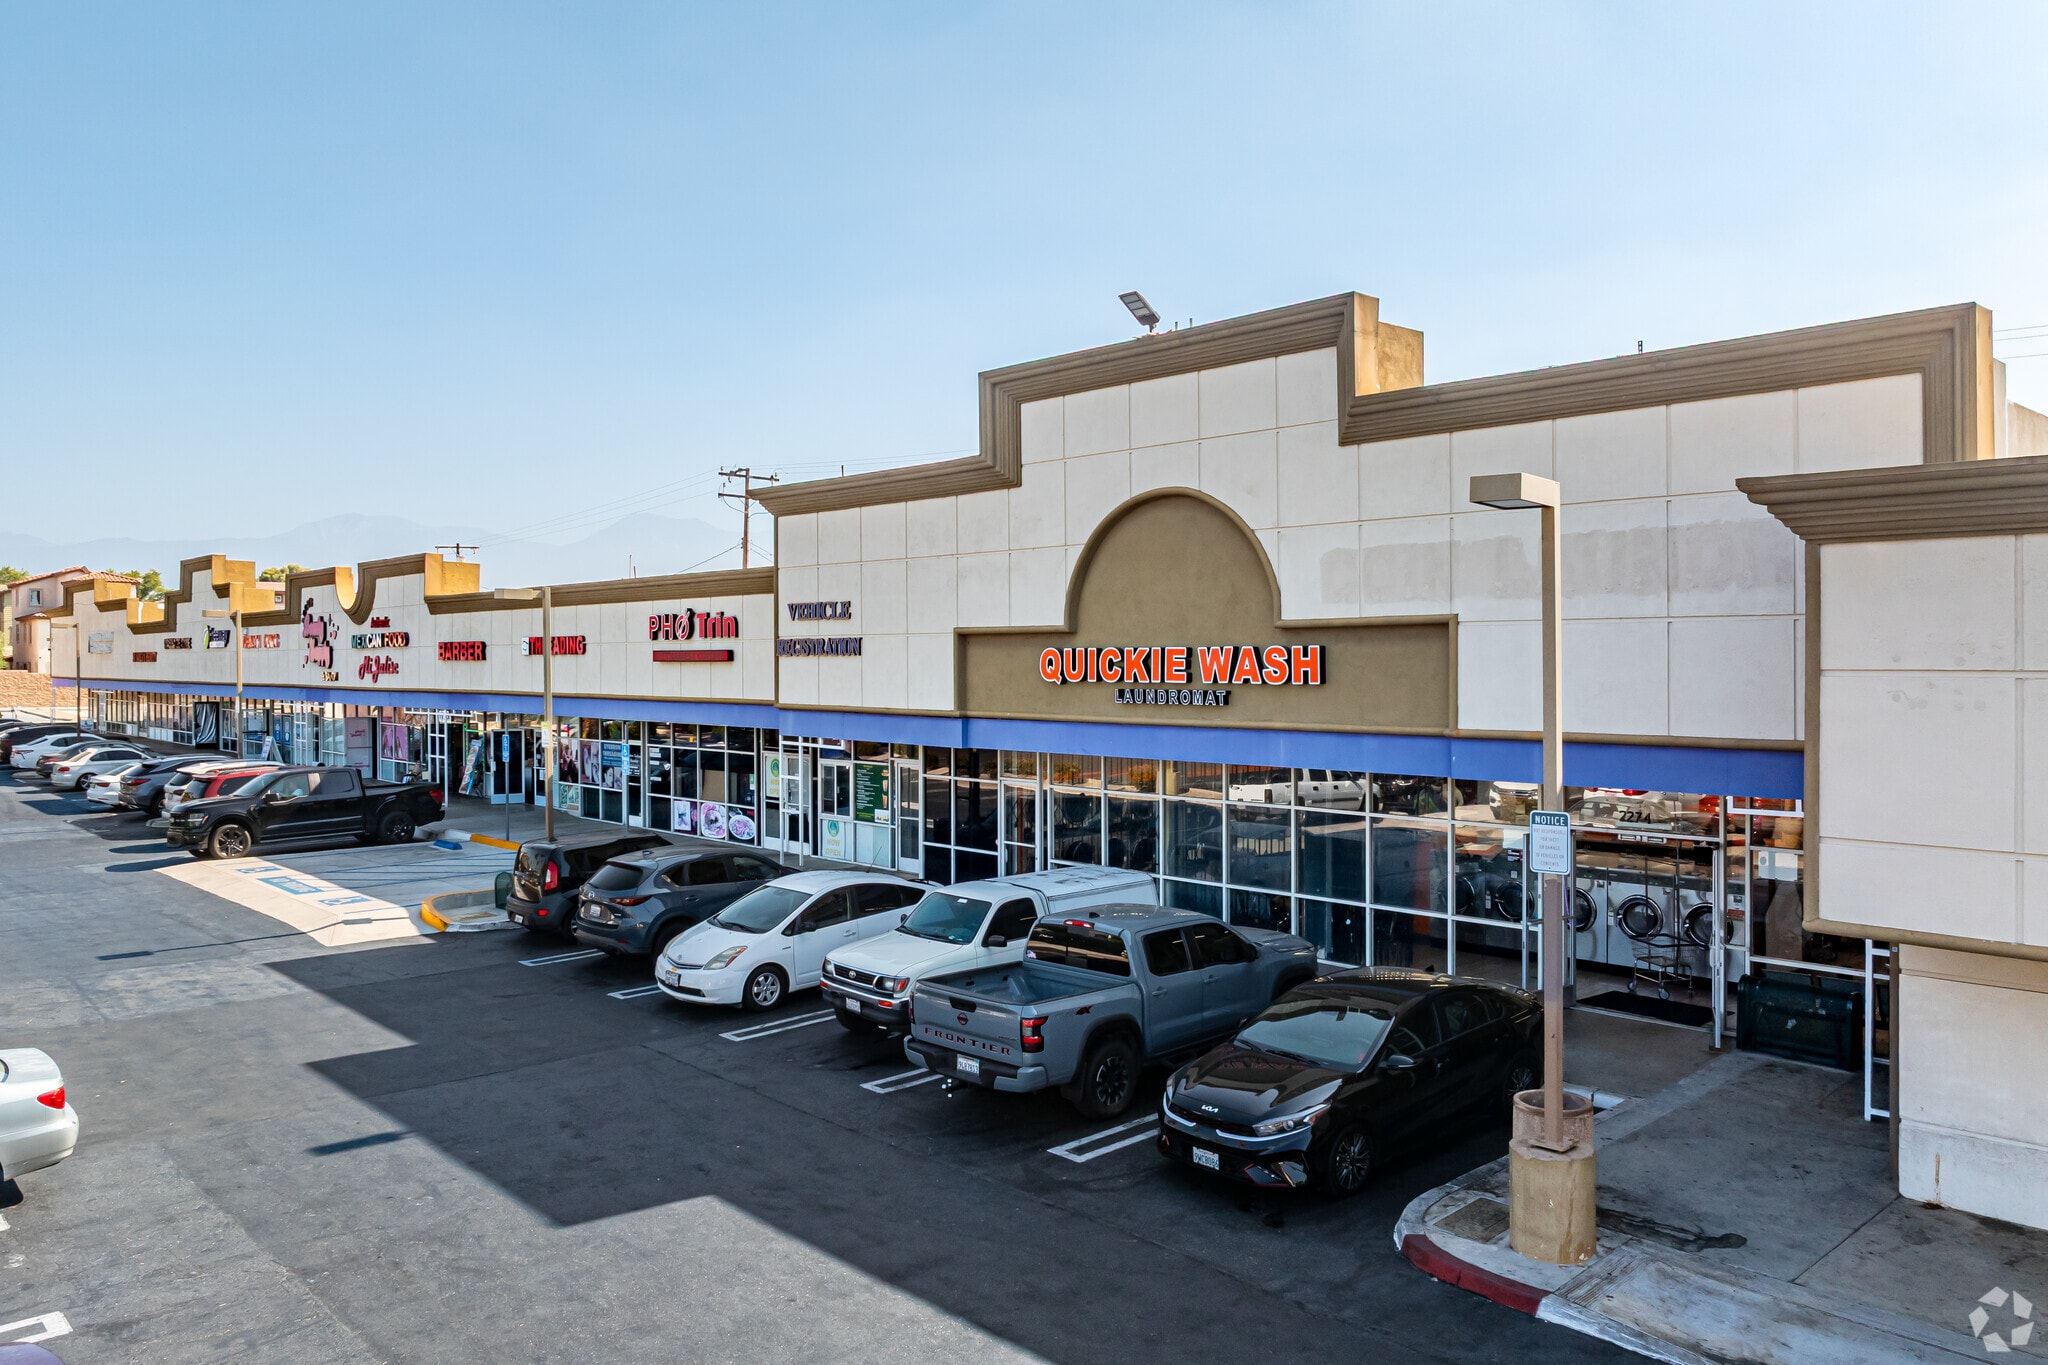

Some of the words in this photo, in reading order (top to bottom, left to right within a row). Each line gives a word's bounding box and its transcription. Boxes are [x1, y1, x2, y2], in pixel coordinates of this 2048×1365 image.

[787, 601, 851, 621] VEHICLE
[696, 611, 738, 639] Trin
[351, 632, 382, 649] MEXICAN
[383, 632, 408, 648] FOOD
[529, 635, 586, 656] THADING
[777, 637, 862, 656] REGISTRATION
[437, 641, 485, 661] BARBER
[1039, 646, 1189, 685] QUICKIE
[1197, 645, 1323, 685] WASH
[1114, 688, 1230, 706] LAUNDROMAT
[1535, 815, 1565, 826] NOTICE
[1619, 811, 1651, 824] 2274
[825, 848, 841, 857] OPEN
[827, 839, 841, 847] NOW
[924, 1027, 1011, 1056] FRONTIER
